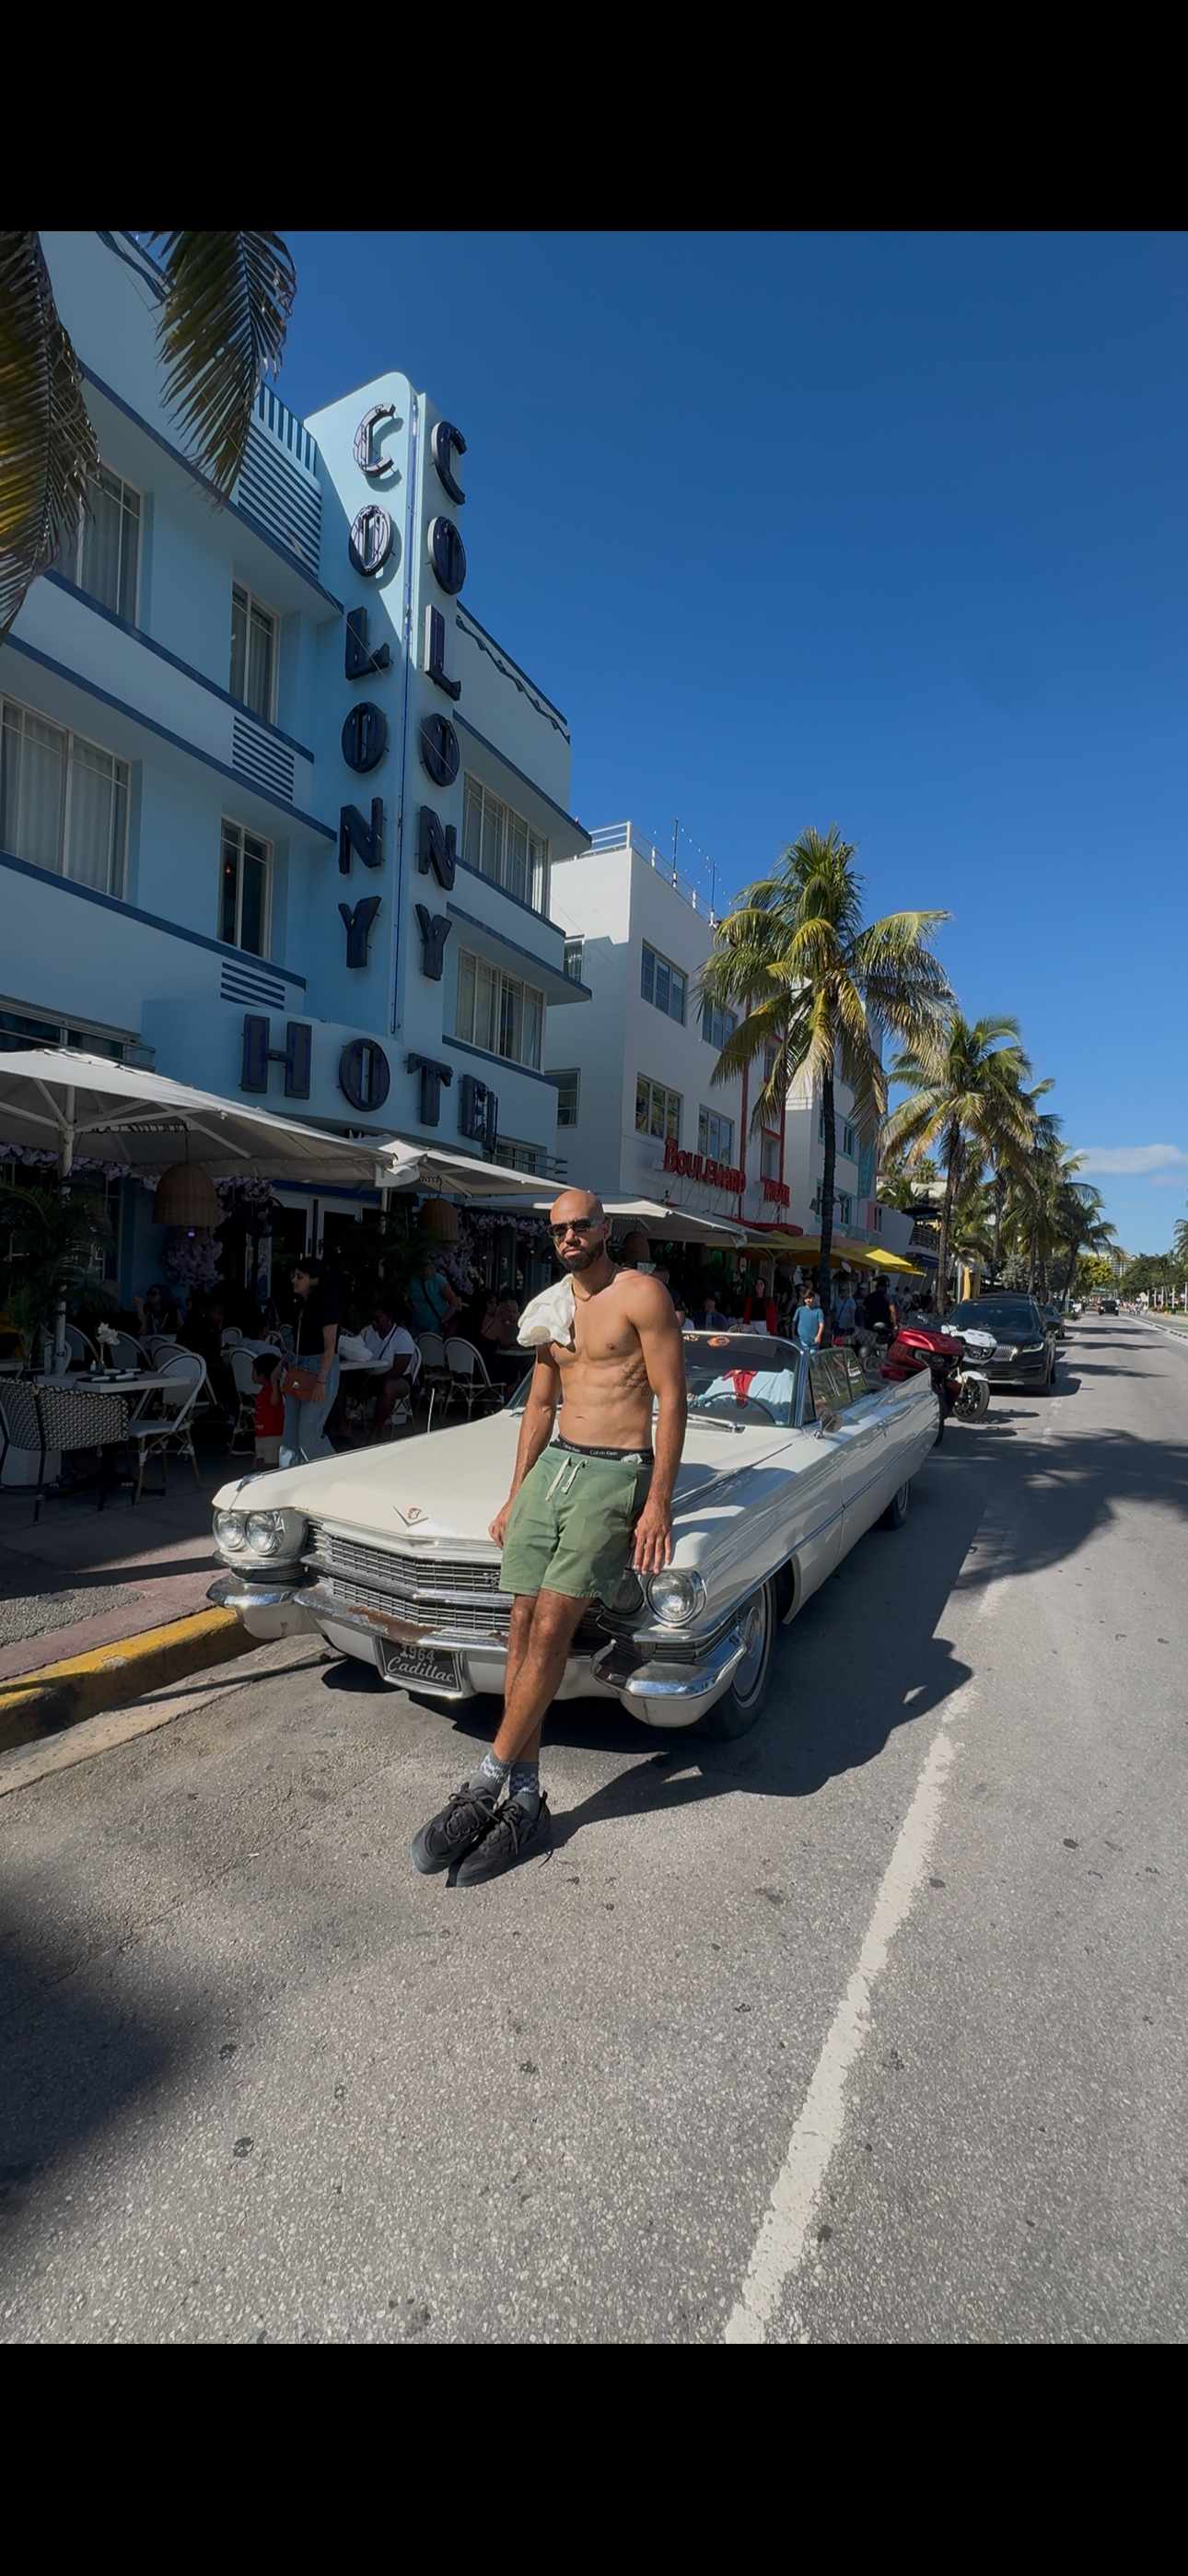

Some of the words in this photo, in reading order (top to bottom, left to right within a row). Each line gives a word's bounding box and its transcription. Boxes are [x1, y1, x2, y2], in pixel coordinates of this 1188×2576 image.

[337, 402, 398, 969] COLONY
[414, 419, 467, 982] COLONY
[240, 1013, 498, 1153] HOTEL
[387, 1657, 454, 1681] Cadillac
[400, 1644, 436, 1663] 1964
